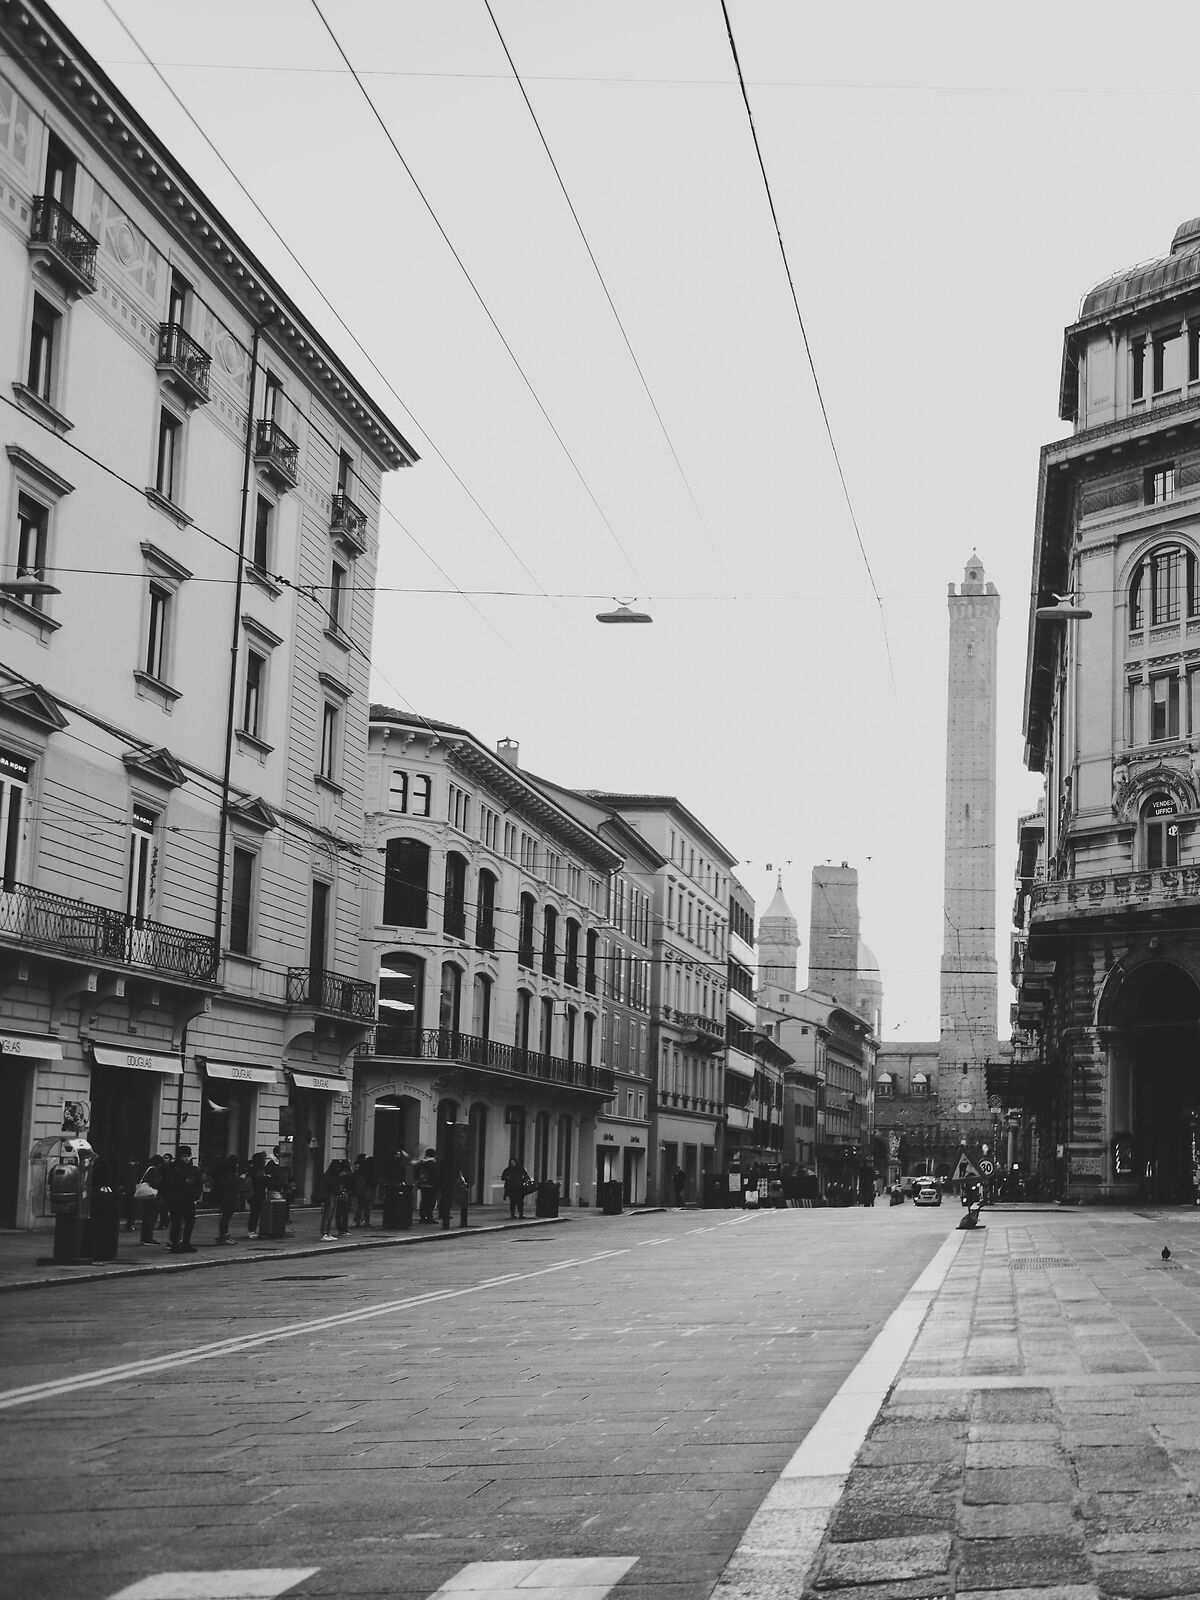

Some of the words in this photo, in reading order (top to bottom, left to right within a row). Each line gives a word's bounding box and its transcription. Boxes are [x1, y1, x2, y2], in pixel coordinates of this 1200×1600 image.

[0, 757, 9, 766] RA
[10, 761, 27, 773] HOME
[1155, 807, 1173, 815] UFFICI
[2, 1039, 21, 1053] GLAS
[127, 1055, 152, 1068] DOUGLAS
[981, 1163, 991, 1172] 30
